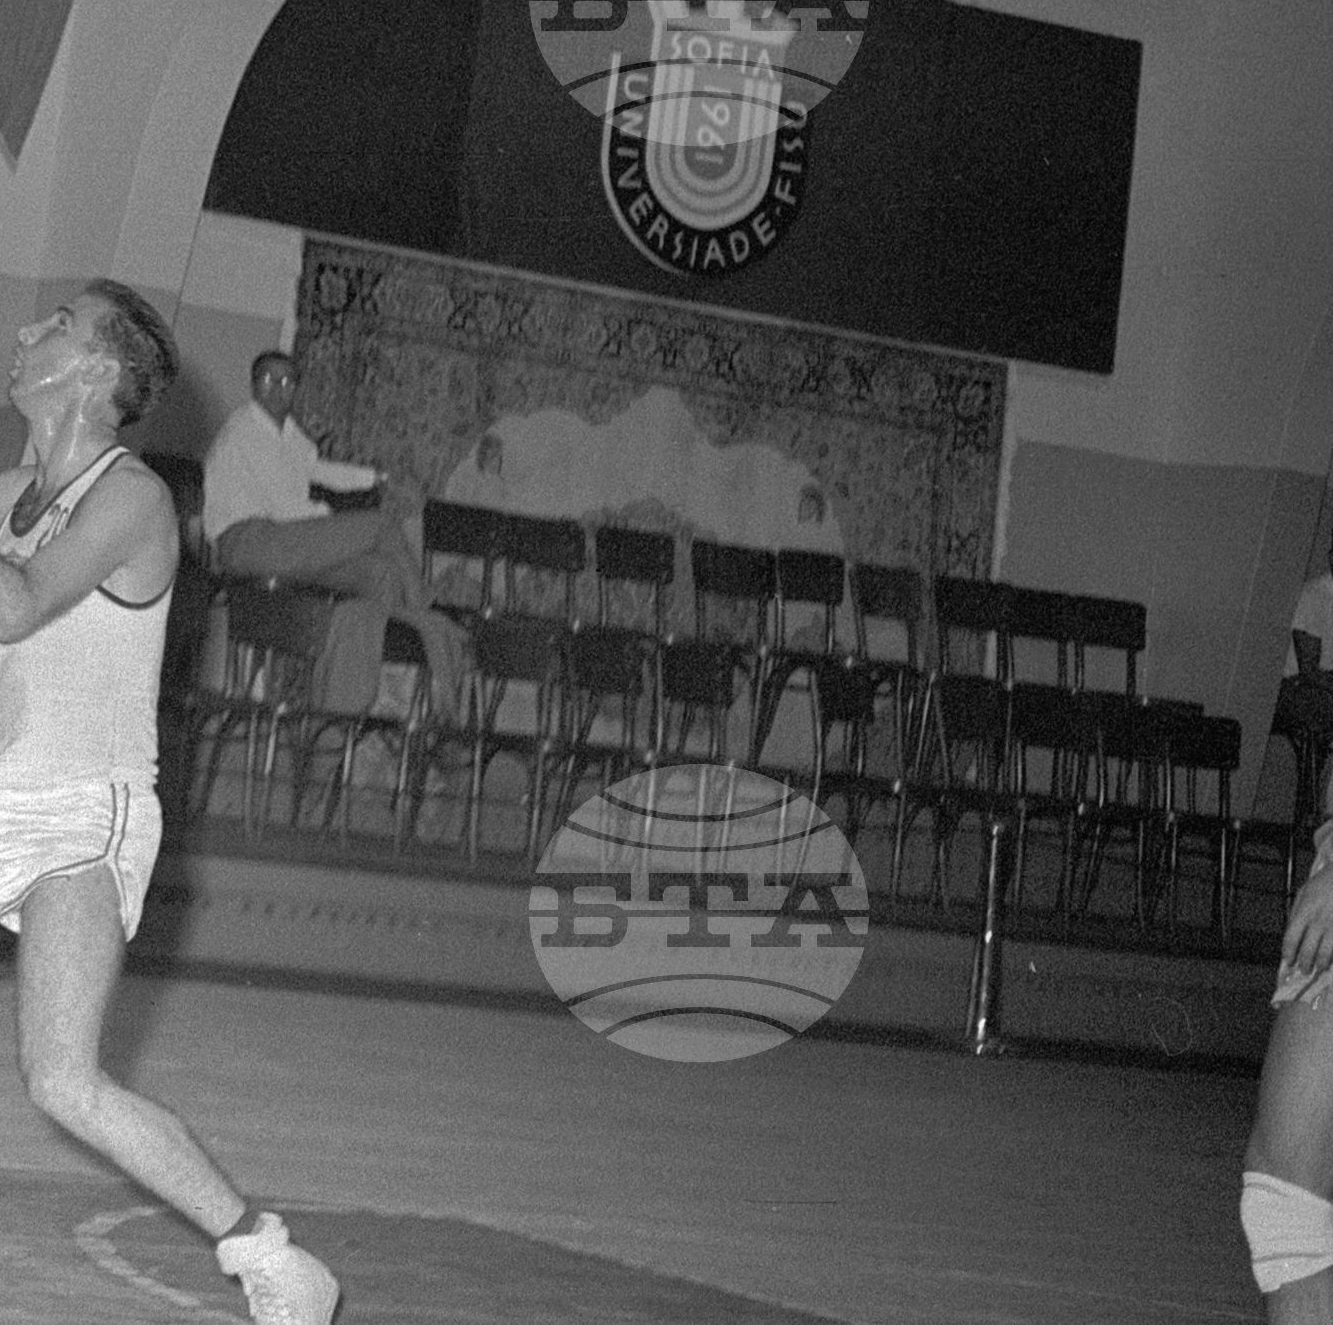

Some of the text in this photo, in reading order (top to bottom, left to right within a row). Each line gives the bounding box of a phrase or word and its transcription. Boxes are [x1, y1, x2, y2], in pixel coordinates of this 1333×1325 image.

[670, 32, 774, 80] SOFIA
[694, 84, 733, 165] 1961
[616, 72, 808, 270] UNIVERSIADE FISU
